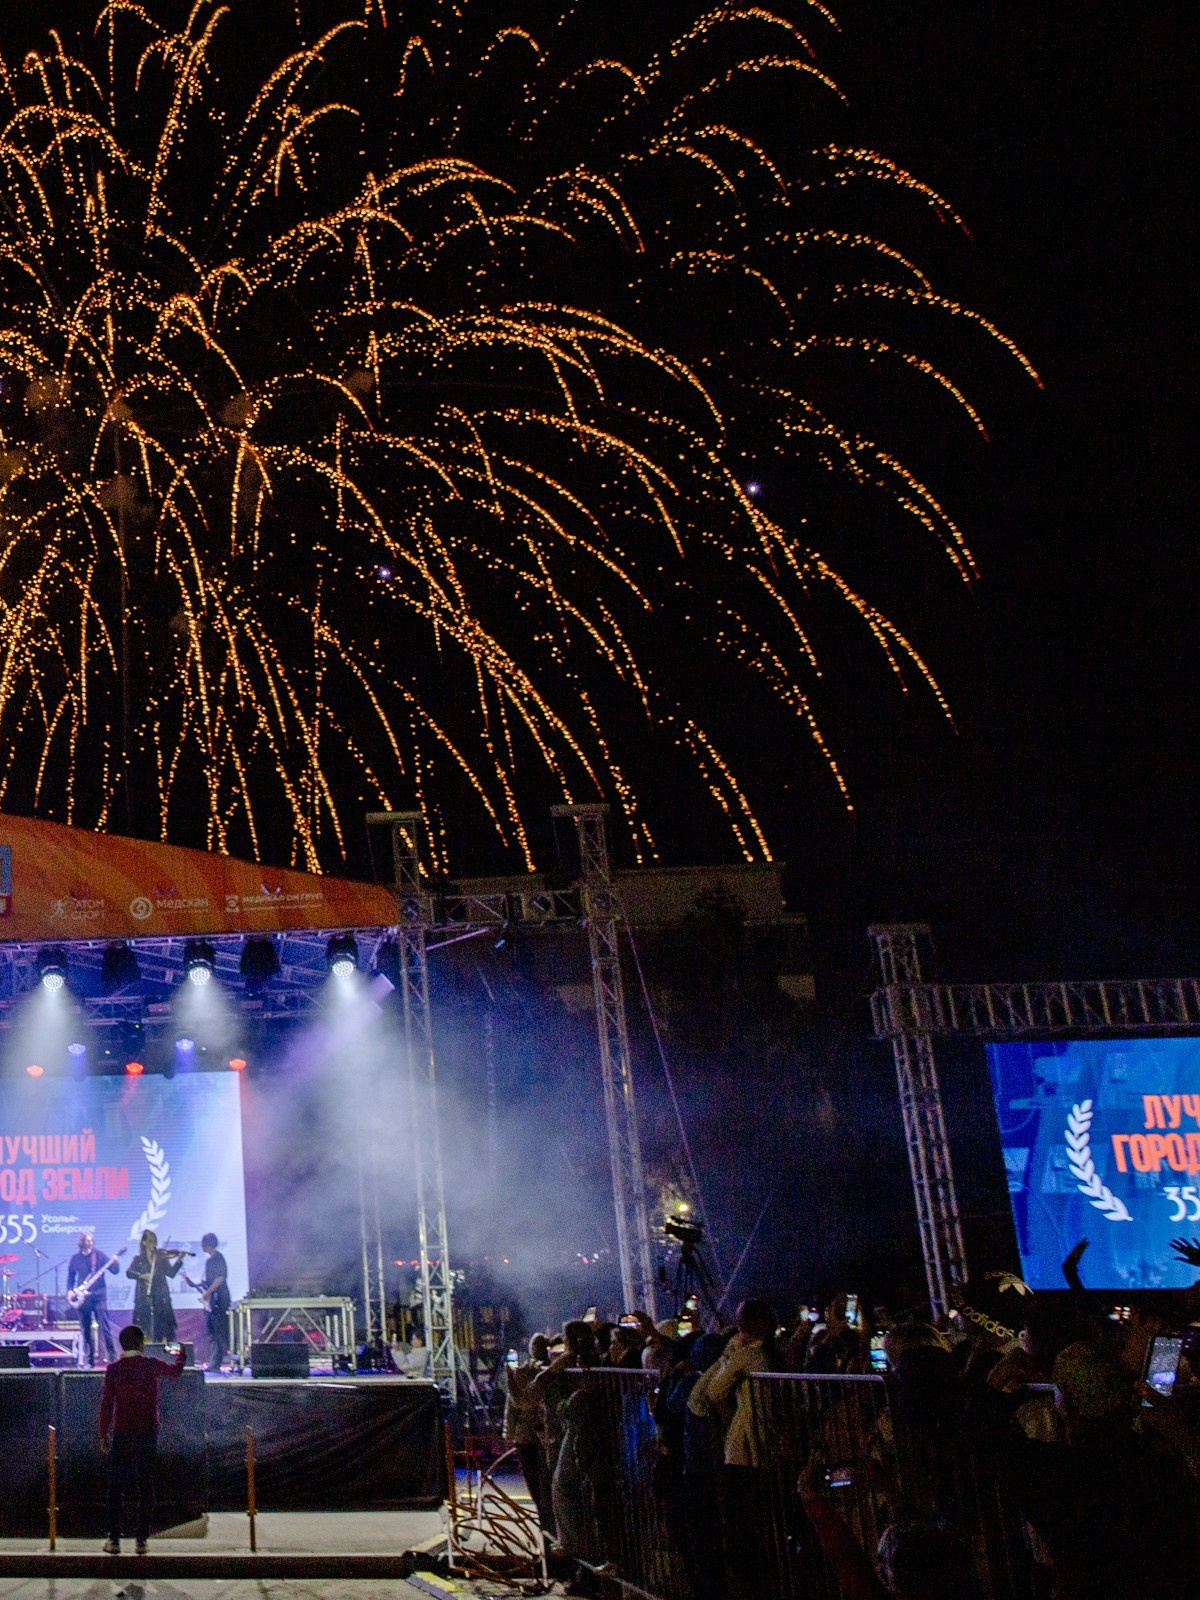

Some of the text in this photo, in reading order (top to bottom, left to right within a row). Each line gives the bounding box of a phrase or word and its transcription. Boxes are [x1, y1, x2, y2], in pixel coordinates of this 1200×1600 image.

[1142, 1094, 1200, 1129] ЛУЧ
[42, 1167, 129, 1200] ЗЕМЛИ
[41, 1213, 79, 1224] Усолье-
[1163, 1186, 1200, 1222] 35
[41, 1223, 96, 1235] Сибирское
[962, 1306, 1015, 1341] adidas
